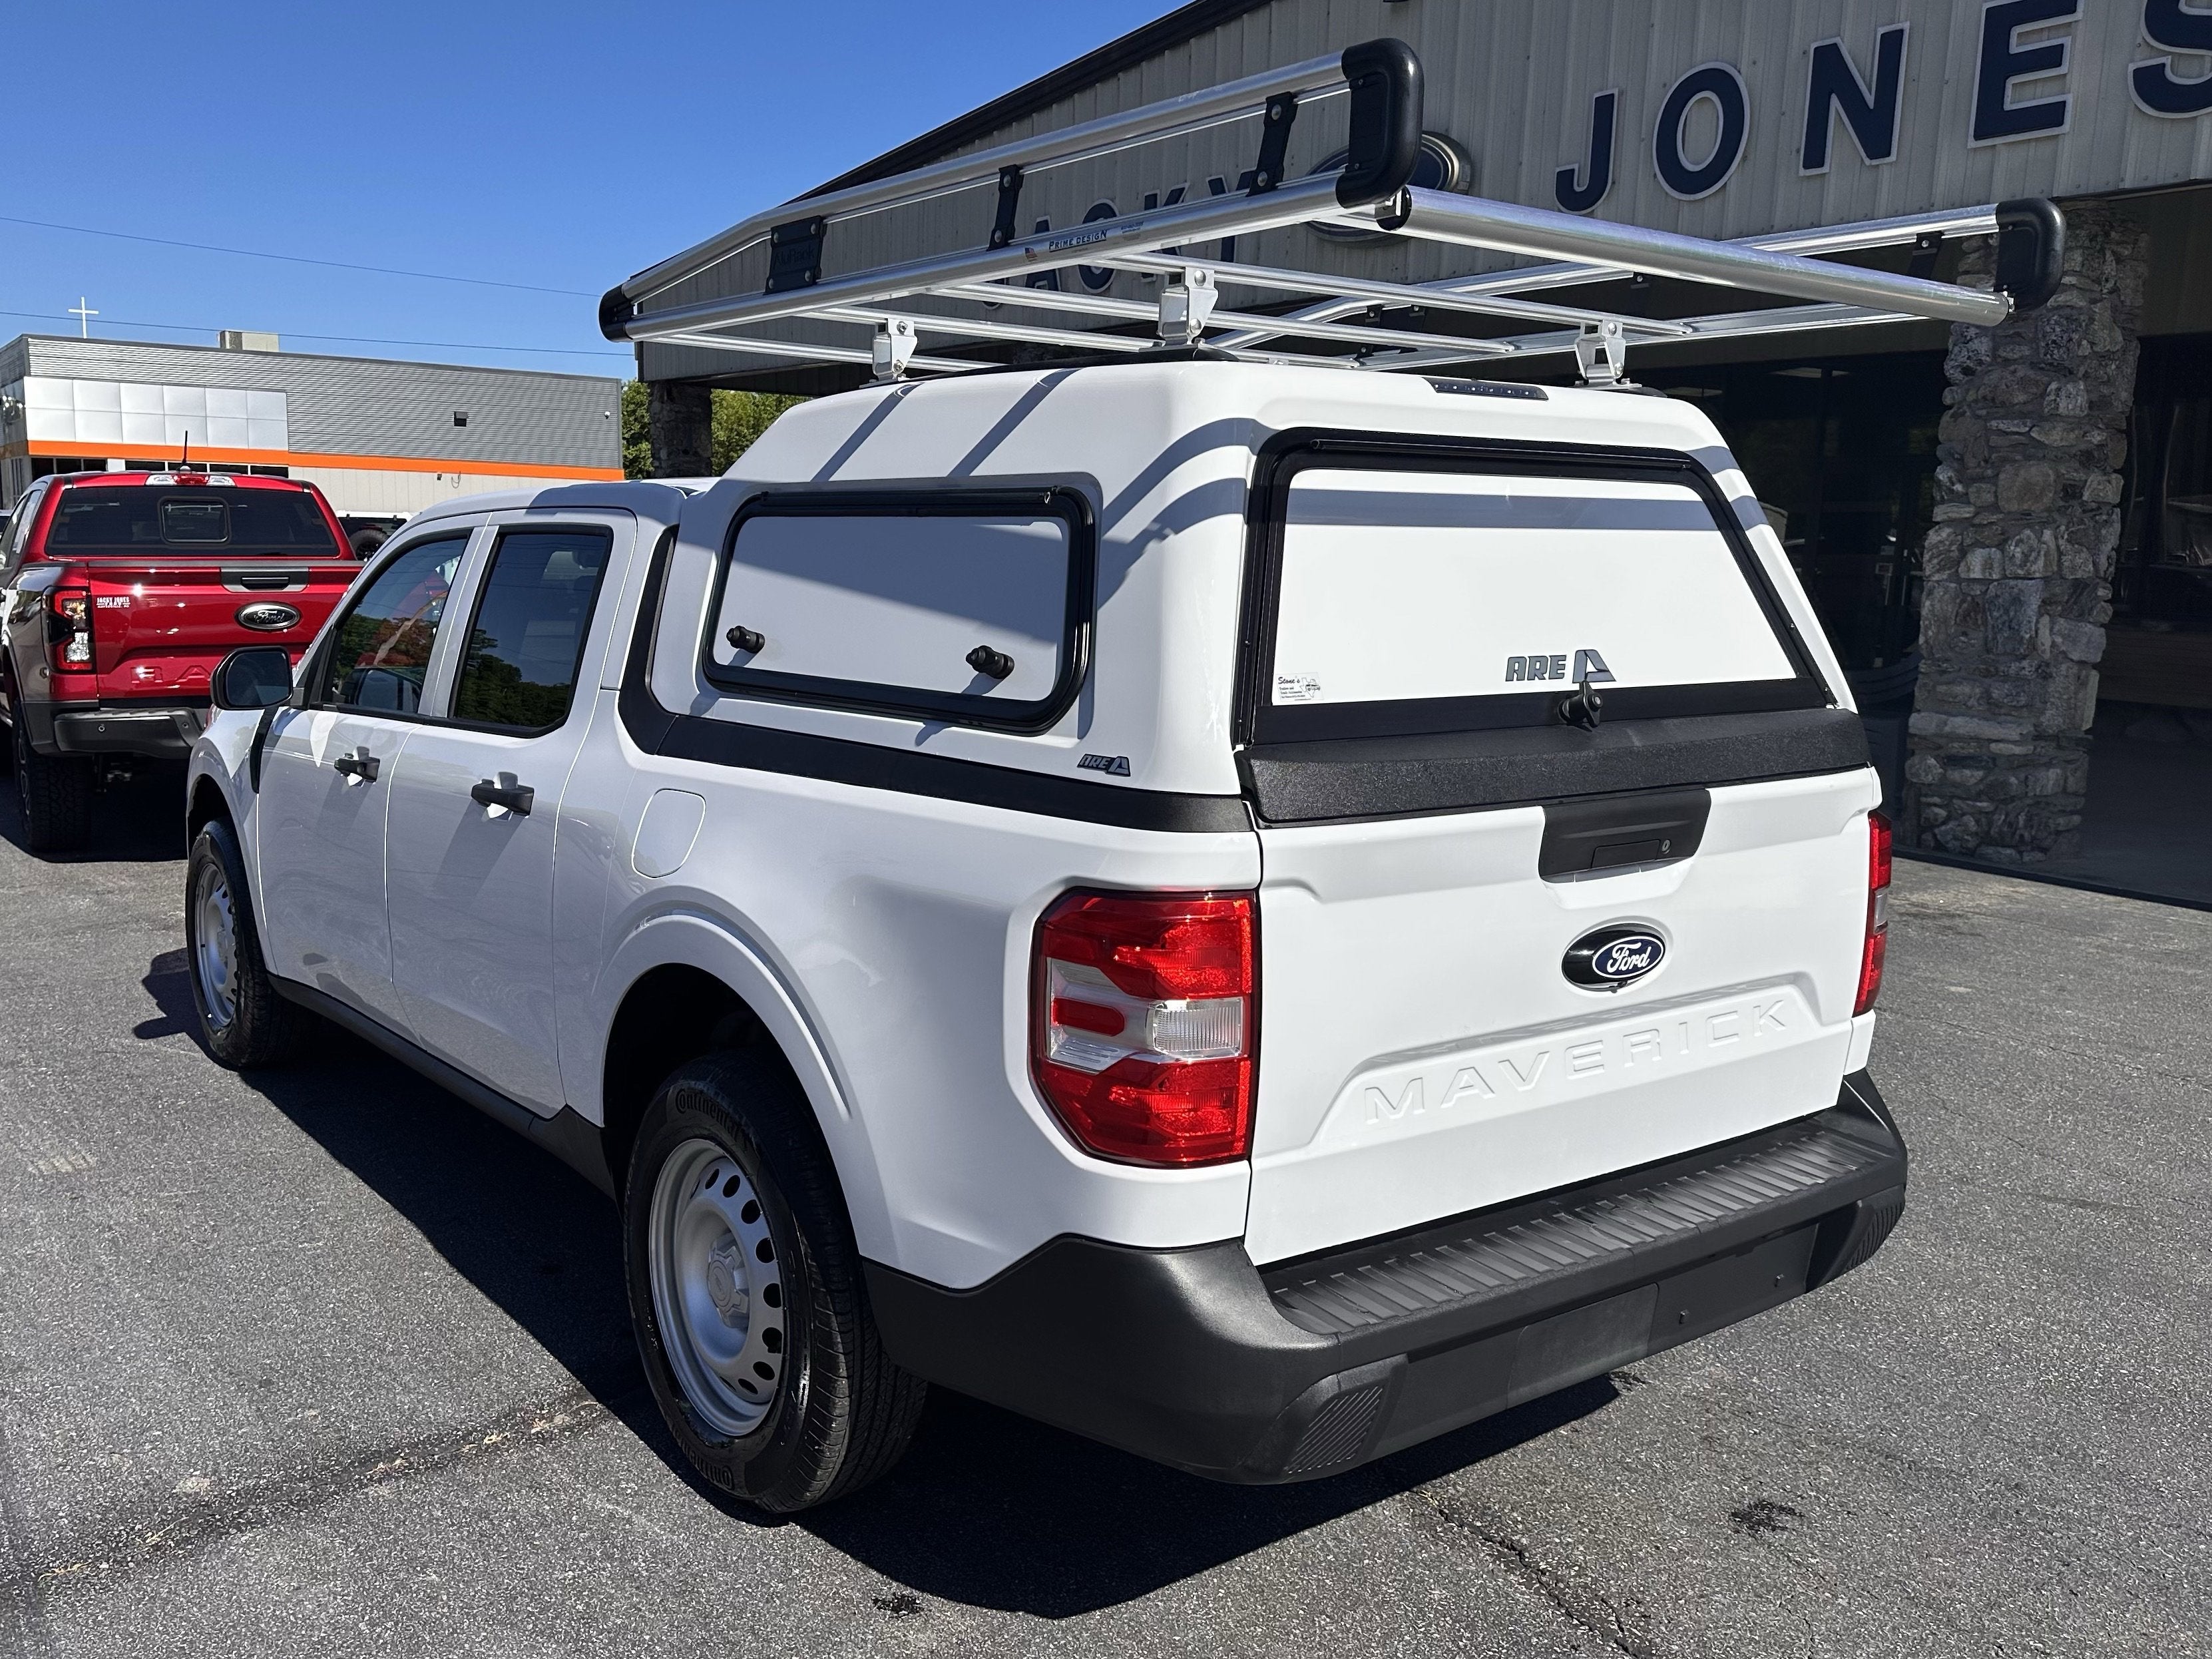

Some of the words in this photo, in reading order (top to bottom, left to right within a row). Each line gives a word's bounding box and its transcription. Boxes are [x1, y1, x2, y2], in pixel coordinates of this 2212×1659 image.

[1554, 0, 2212, 215] JONES
[1049, 238, 1074, 250] PRIME
[1076, 230, 1108, 244] DESIGN
[254, 610, 285, 623] Ford
[1505, 654, 1566, 682] ARE
[1078, 754, 1112, 770] ARE
[1606, 942, 1652, 973] Ford
[1365, 1000, 1787, 1124] MAVERICK
